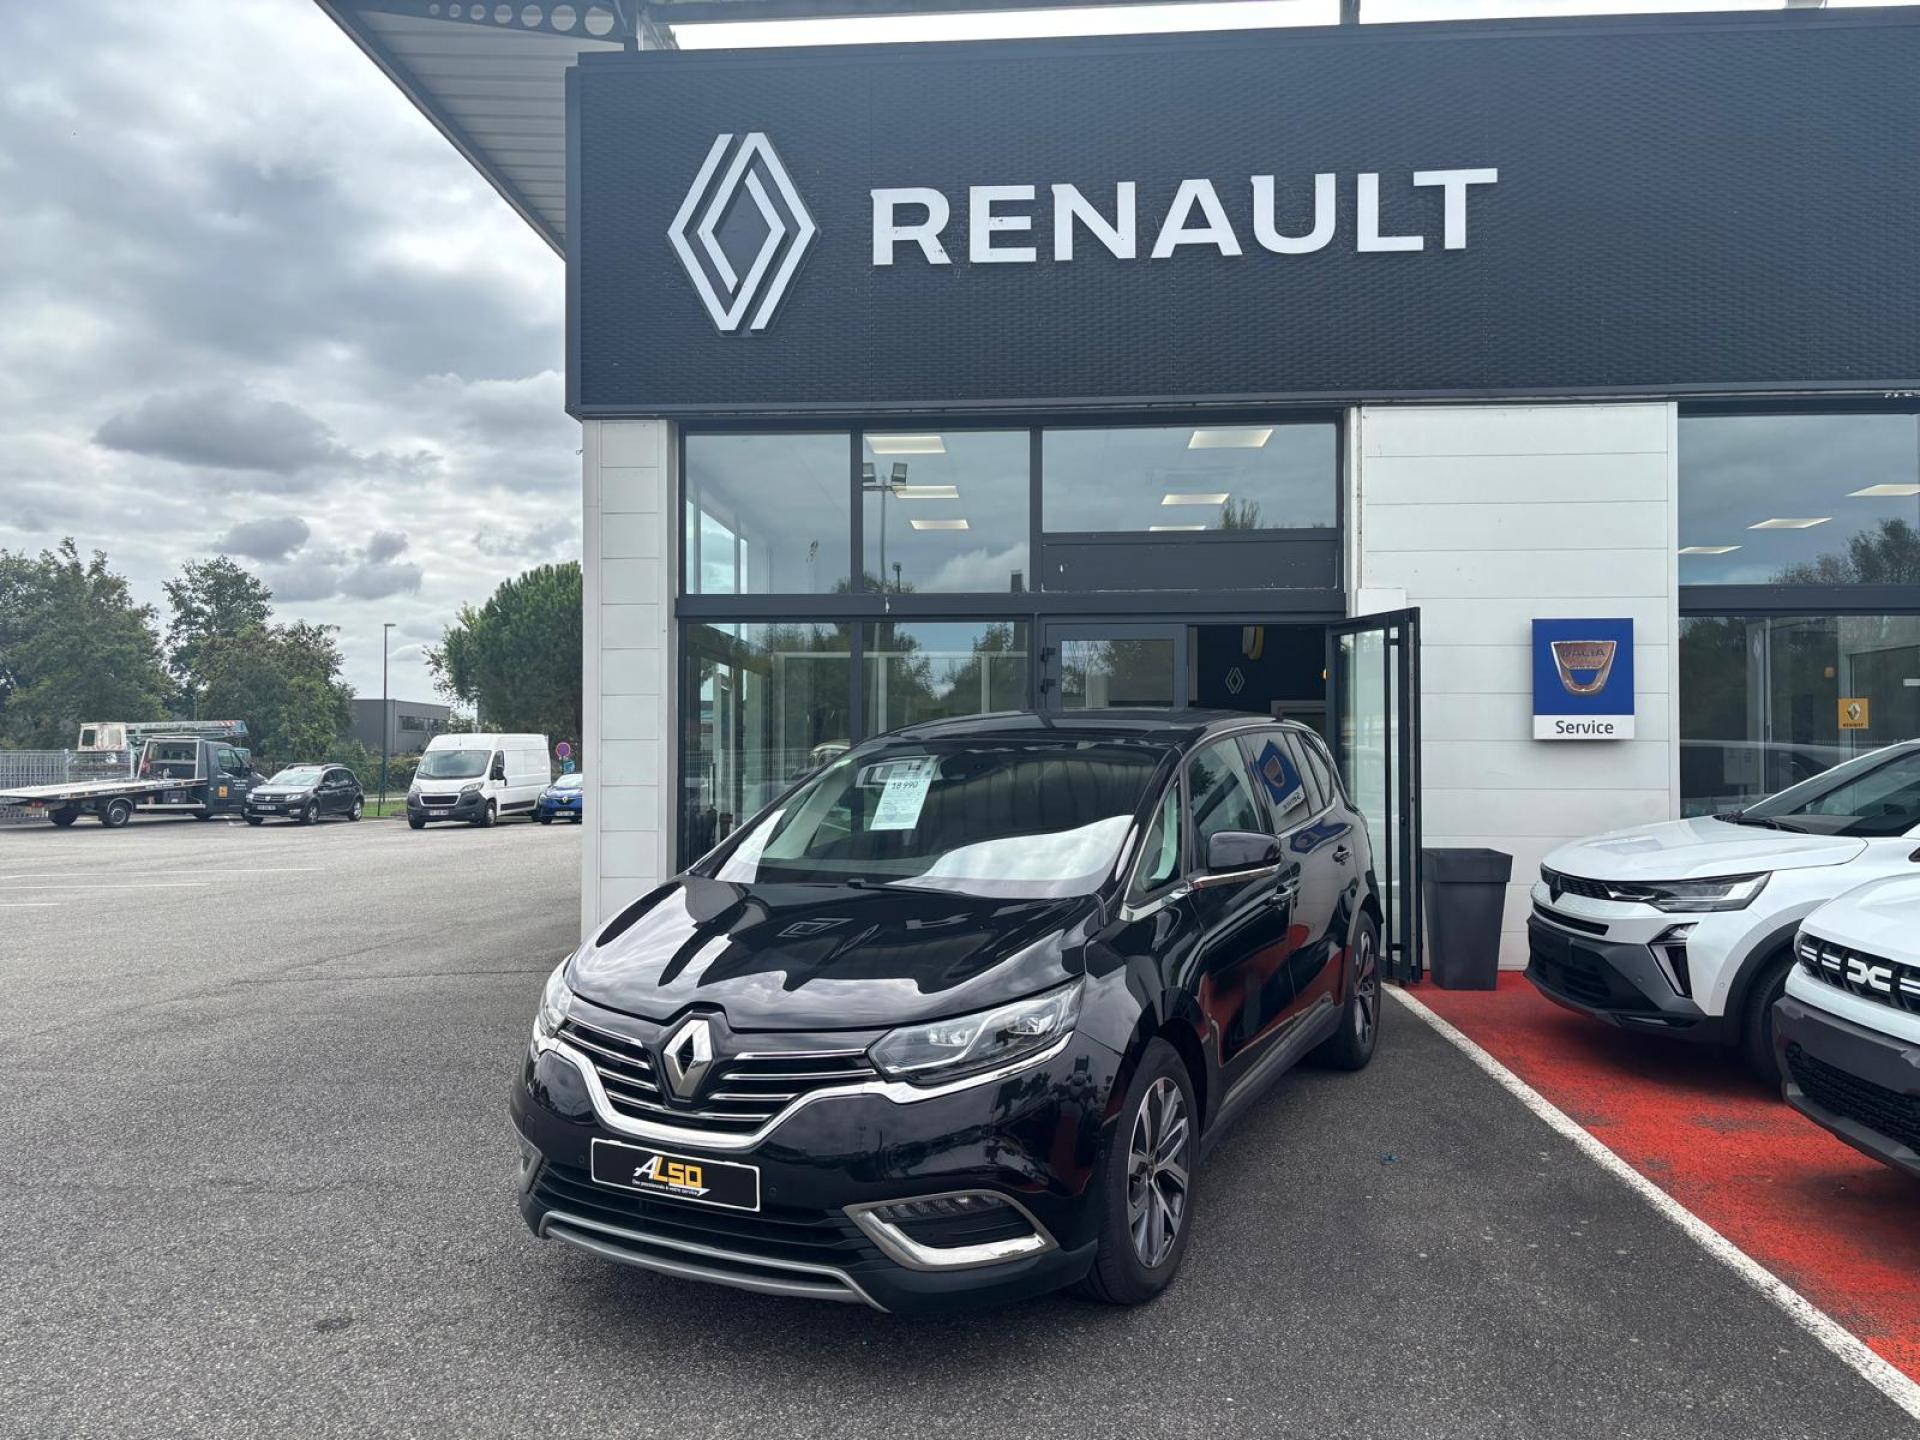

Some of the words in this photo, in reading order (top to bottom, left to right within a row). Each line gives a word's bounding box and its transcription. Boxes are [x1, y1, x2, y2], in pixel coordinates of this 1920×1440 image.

[870, 167, 1499, 266] RENAULT
[1555, 720, 1614, 734] Service
[633, 1156, 703, 1188] ALSO
